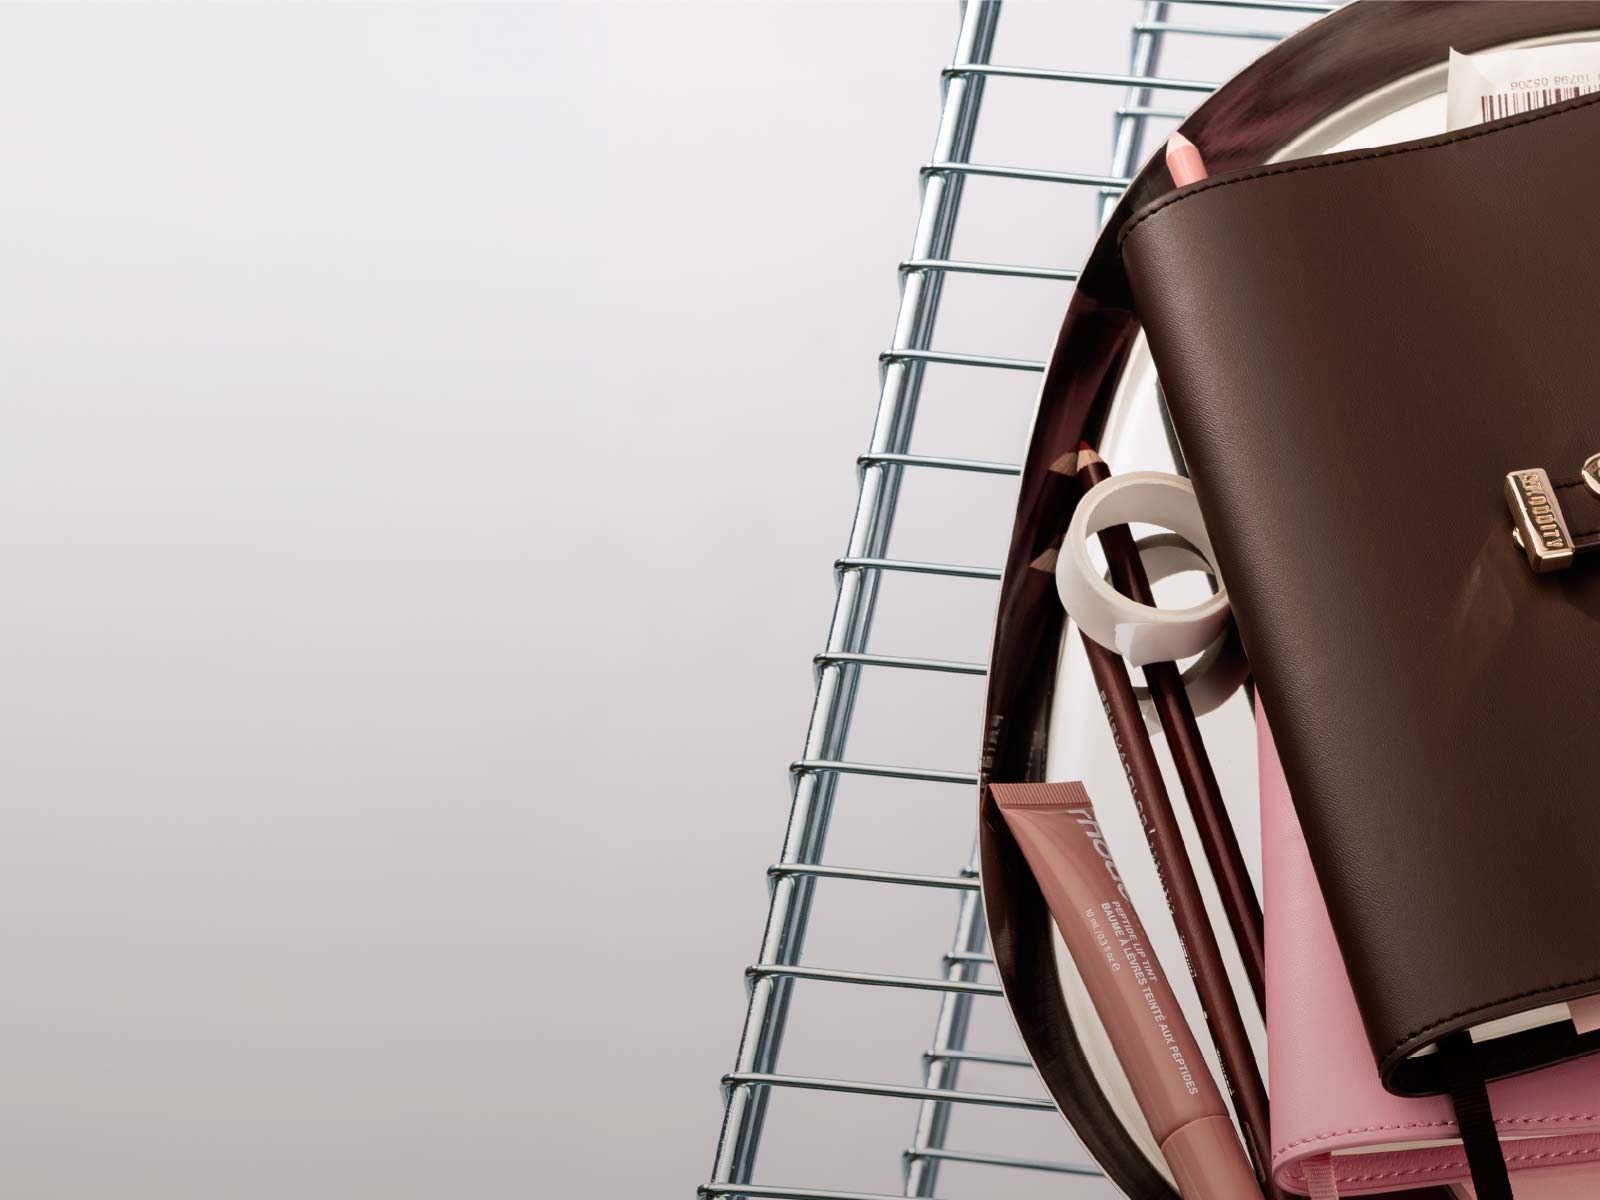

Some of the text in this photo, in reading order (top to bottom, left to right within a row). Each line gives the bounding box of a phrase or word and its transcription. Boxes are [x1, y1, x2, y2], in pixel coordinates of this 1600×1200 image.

[1100, 902, 1125, 937] BAUME
[1159, 1023, 1176, 1045] AUX
[1169, 1045, 1199, 1096] PEPTIDES
[1112, 901, 1158, 982] PEPTIDE LIP TINT
